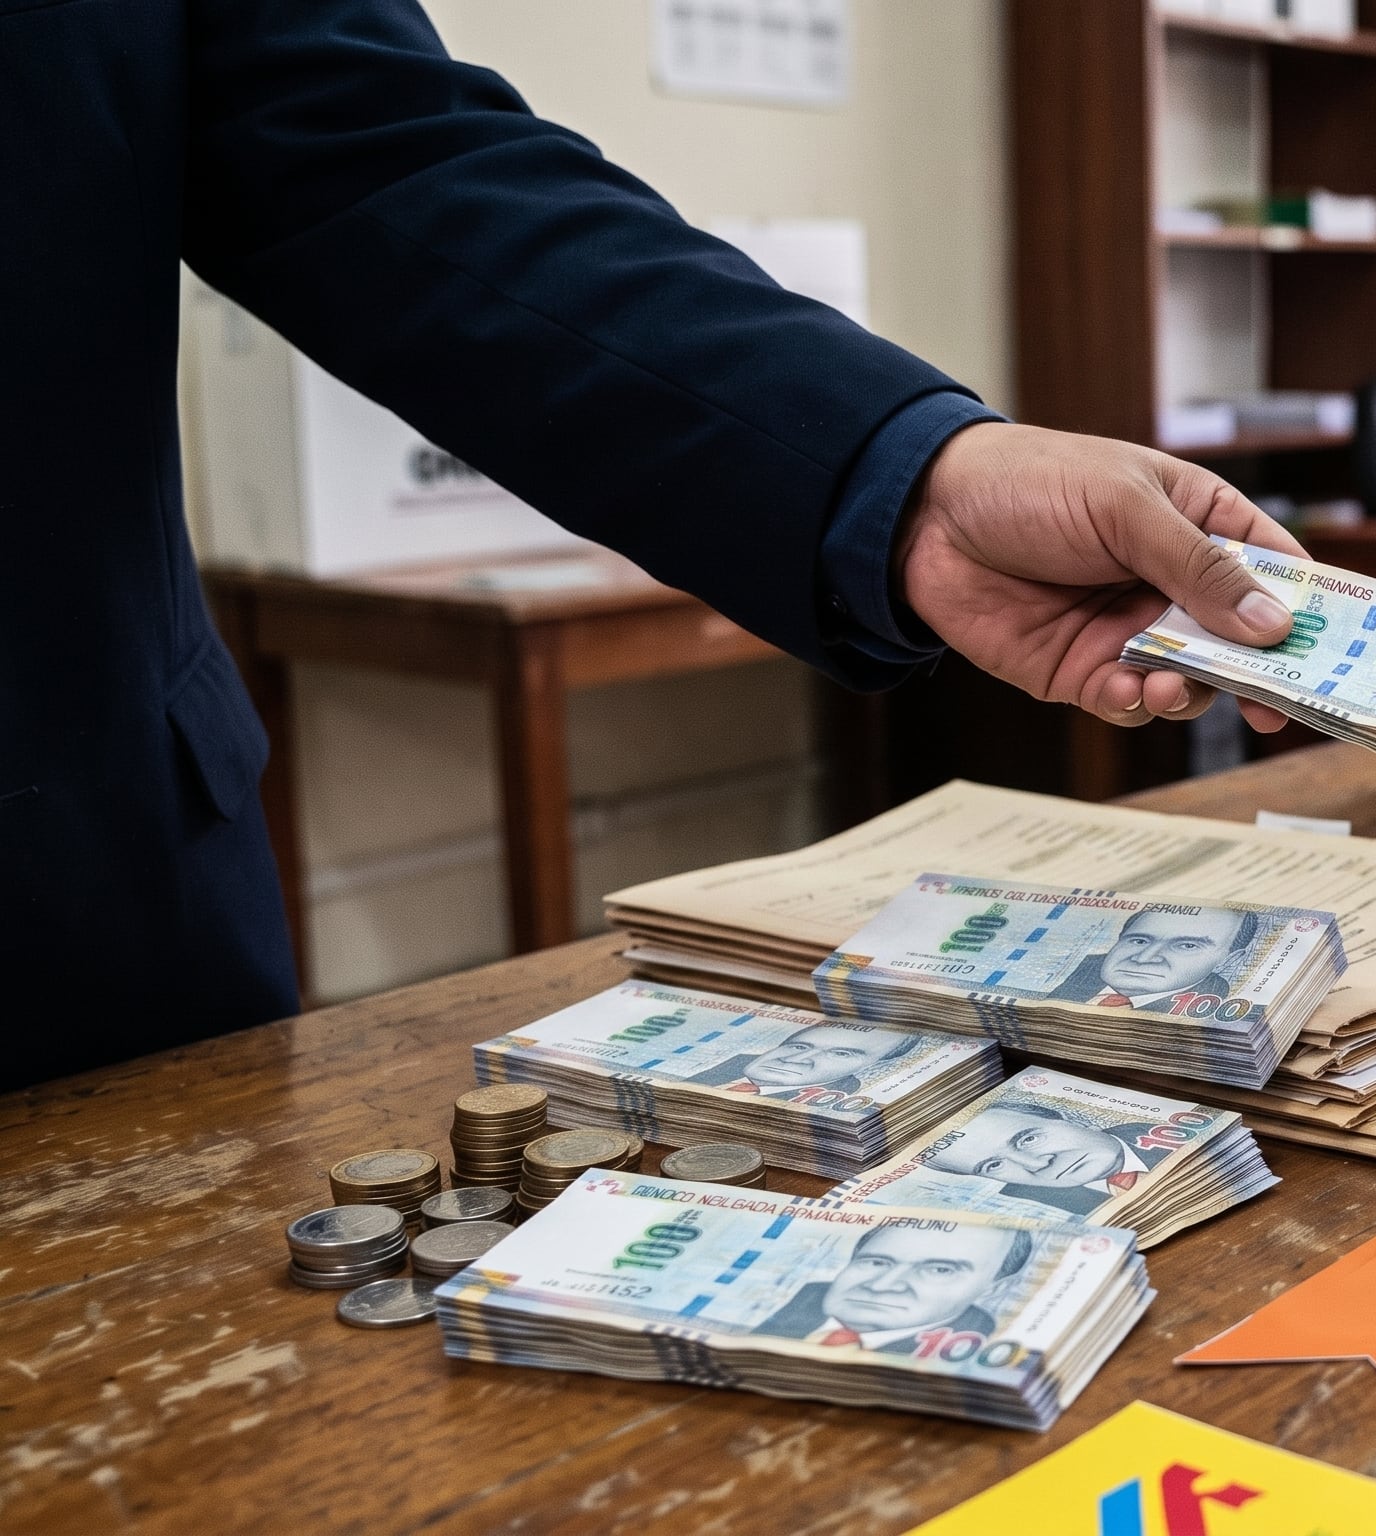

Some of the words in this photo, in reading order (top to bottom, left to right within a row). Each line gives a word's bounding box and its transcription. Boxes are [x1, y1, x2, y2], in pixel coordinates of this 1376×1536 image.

[939, 915, 1009, 953] 100
[1168, 992, 1252, 1022] 100
[607, 1014, 688, 1044] 100
[789, 1086, 873, 1112] 100
[1136, 1111, 1214, 1151] 100
[613, 1222, 703, 1271] 100
[912, 1327, 1023, 1368] 100
